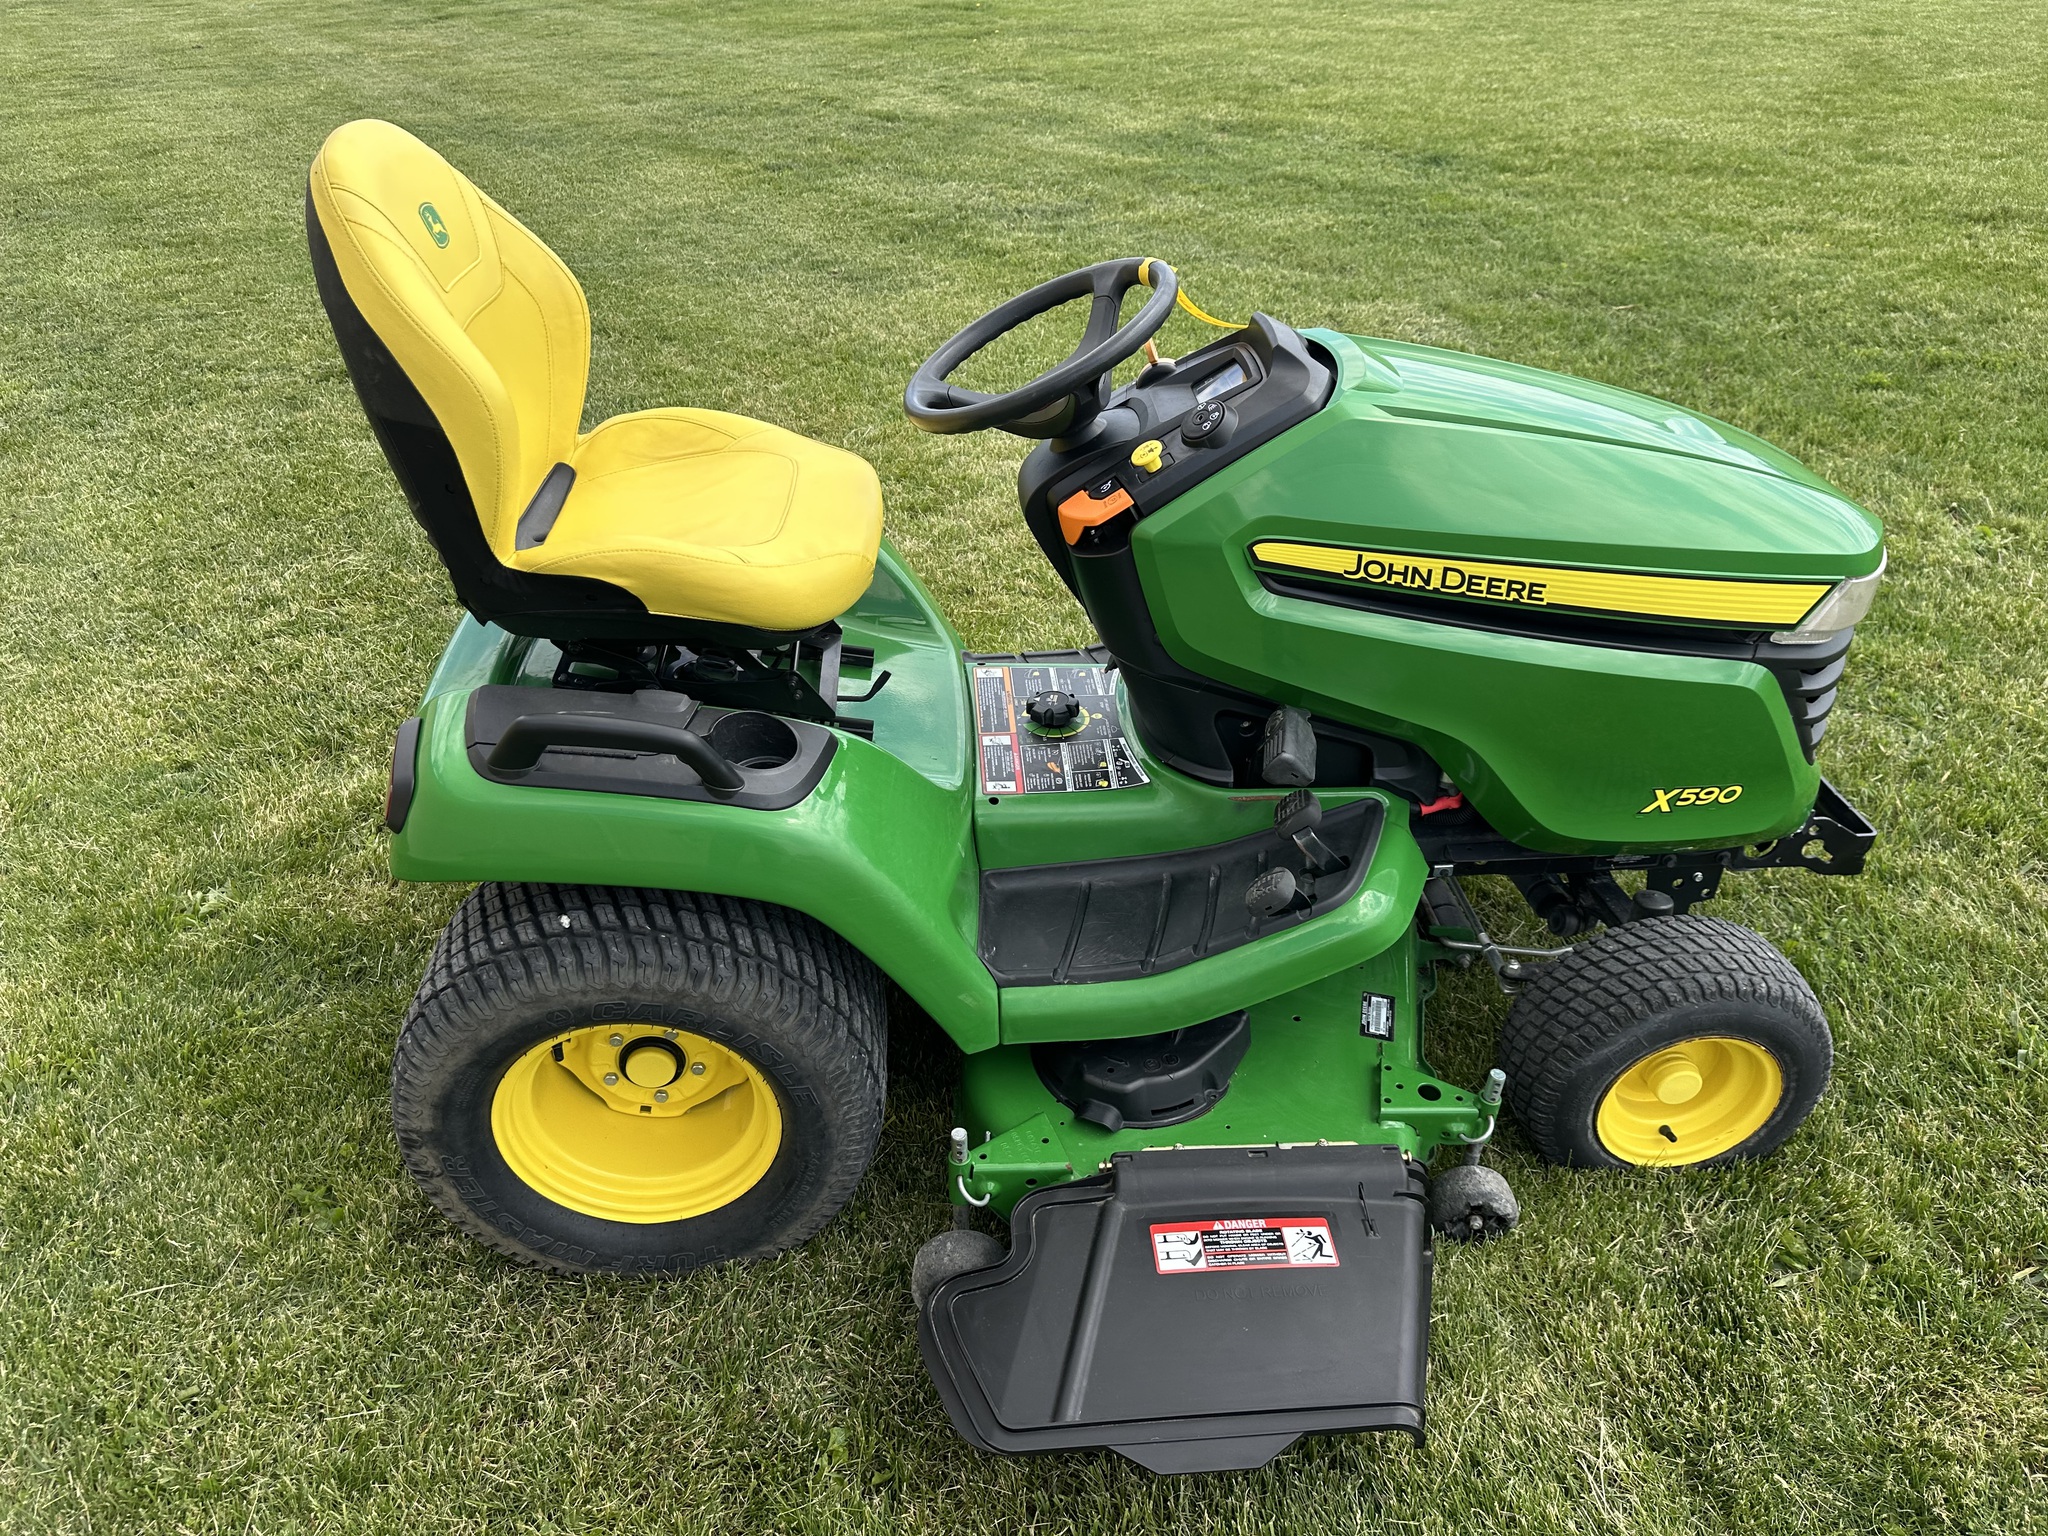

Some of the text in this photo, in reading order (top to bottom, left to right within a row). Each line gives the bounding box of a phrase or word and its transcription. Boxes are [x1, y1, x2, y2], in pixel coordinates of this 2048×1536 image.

[1343, 554, 1547, 603] JOHN DEERE
[1637, 784, 1744, 815] X590
[590, 1000, 821, 1109] CARLISLE
[440, 1154, 727, 1274] TURF MASTER
[1224, 1219, 1267, 1230] DANGER
[1194, 1283, 1328, 1302] DO NOT REMOVE
